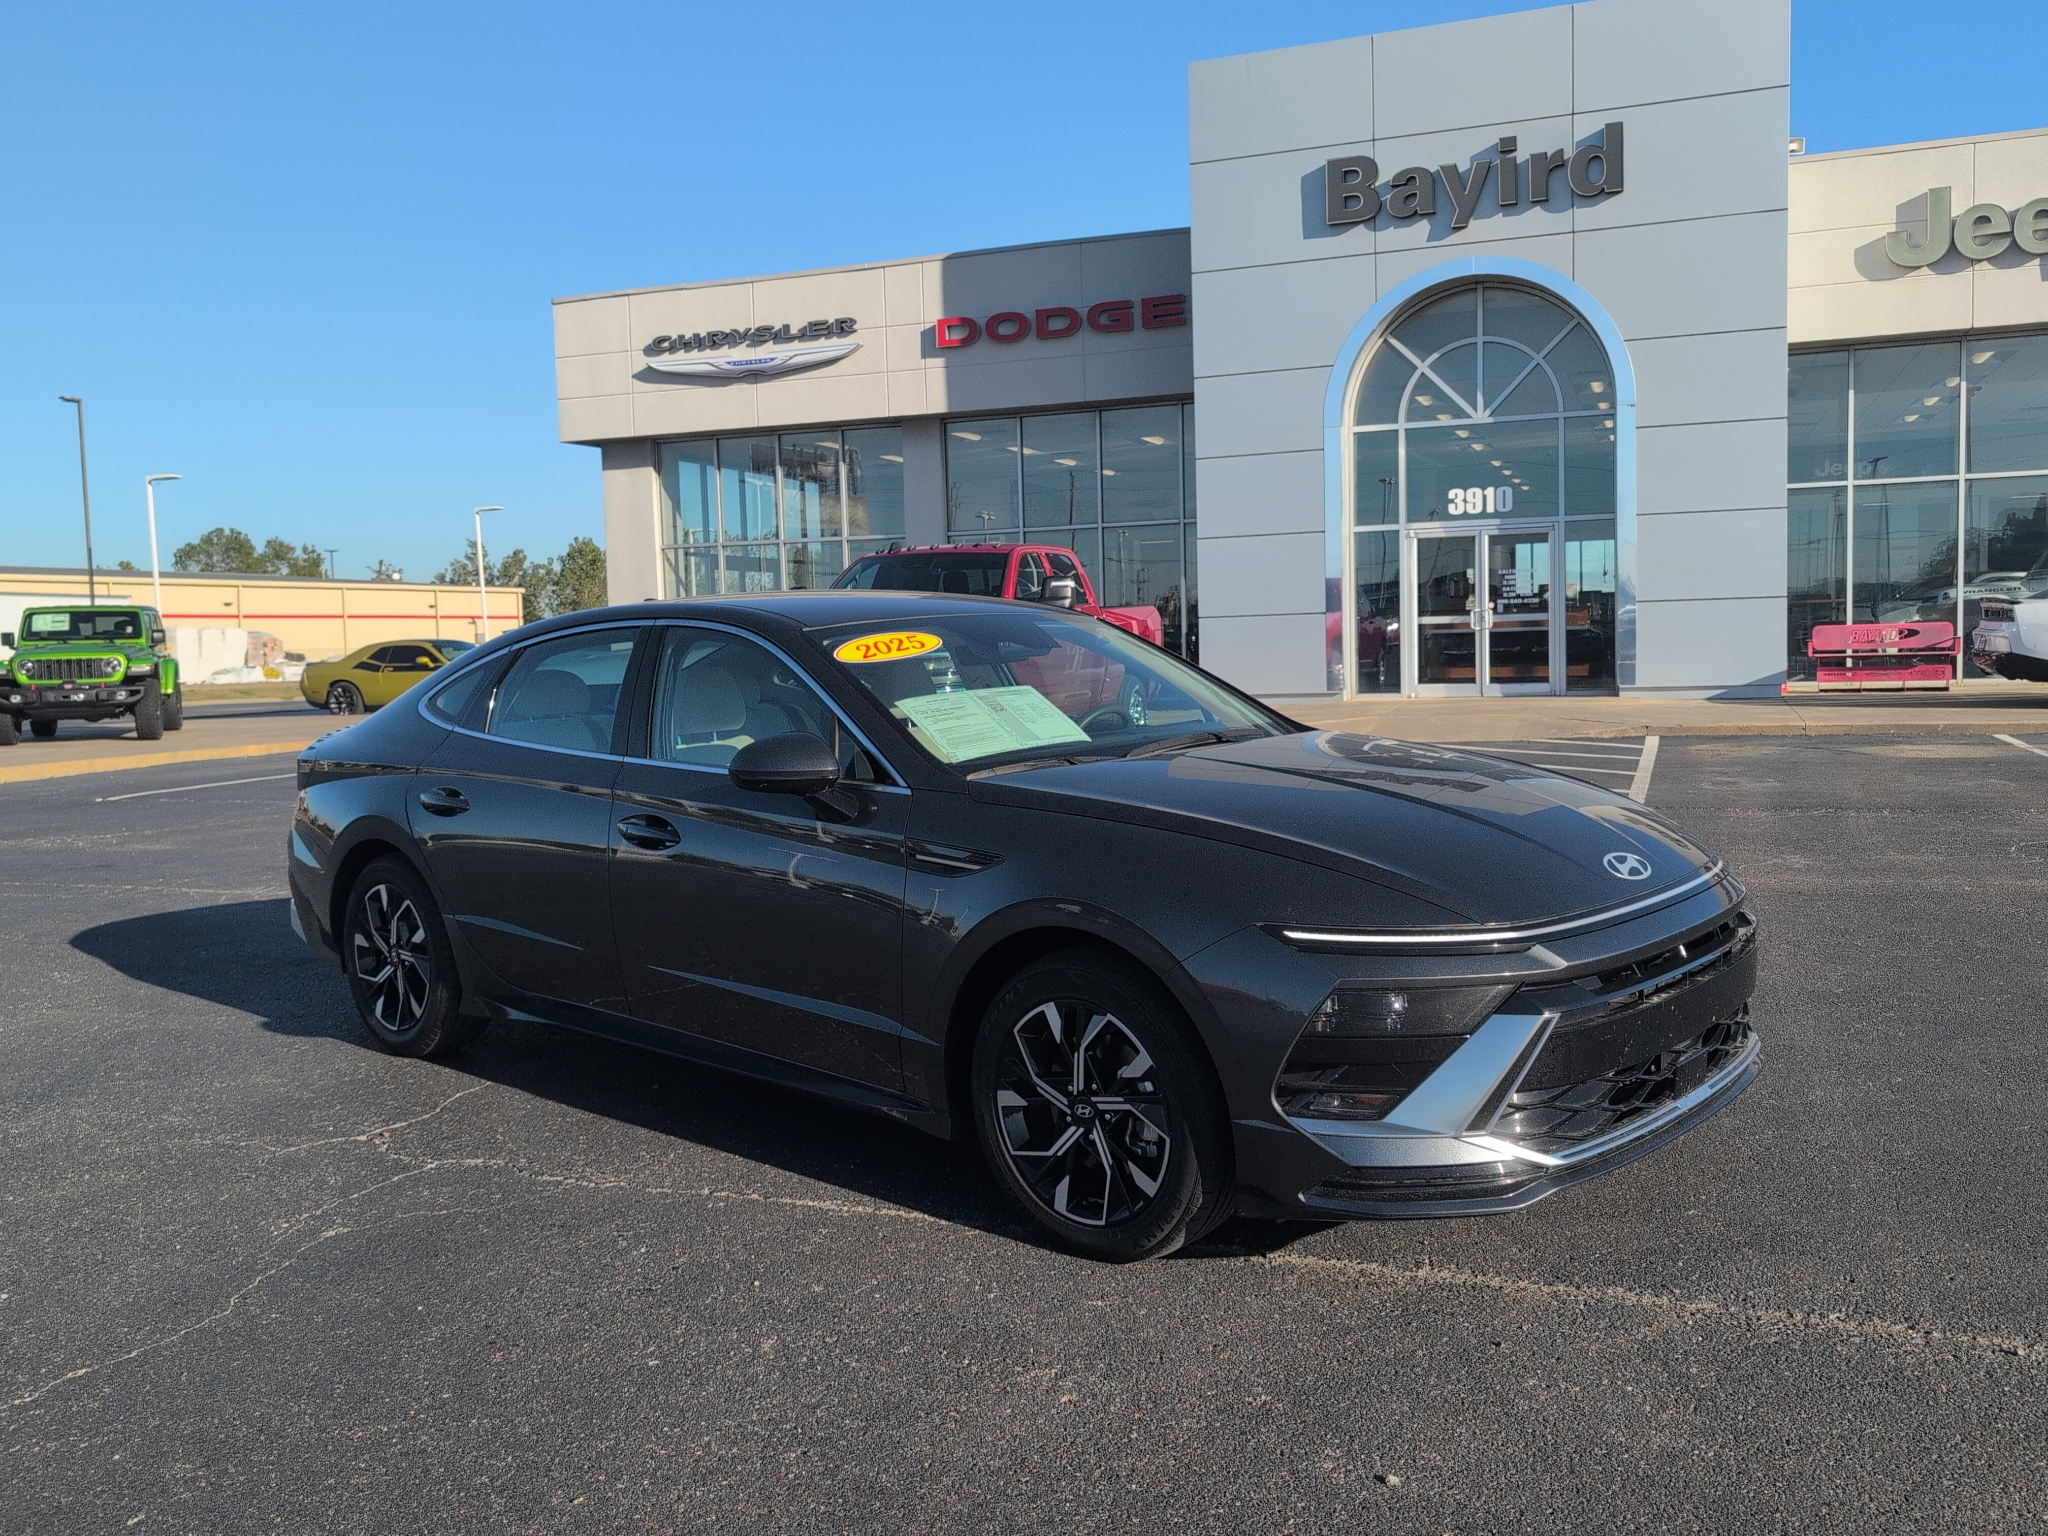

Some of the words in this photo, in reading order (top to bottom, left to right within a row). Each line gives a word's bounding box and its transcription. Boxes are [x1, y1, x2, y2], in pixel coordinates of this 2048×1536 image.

[1326, 121, 1624, 229] Bayird
[651, 317, 857, 351] CHRYSLER
[936, 294, 1187, 348] DODGE
[1814, 460, 1872, 478] Jep
[1447, 486, 1513, 515] 3910
[856, 635, 926, 659] 2025
